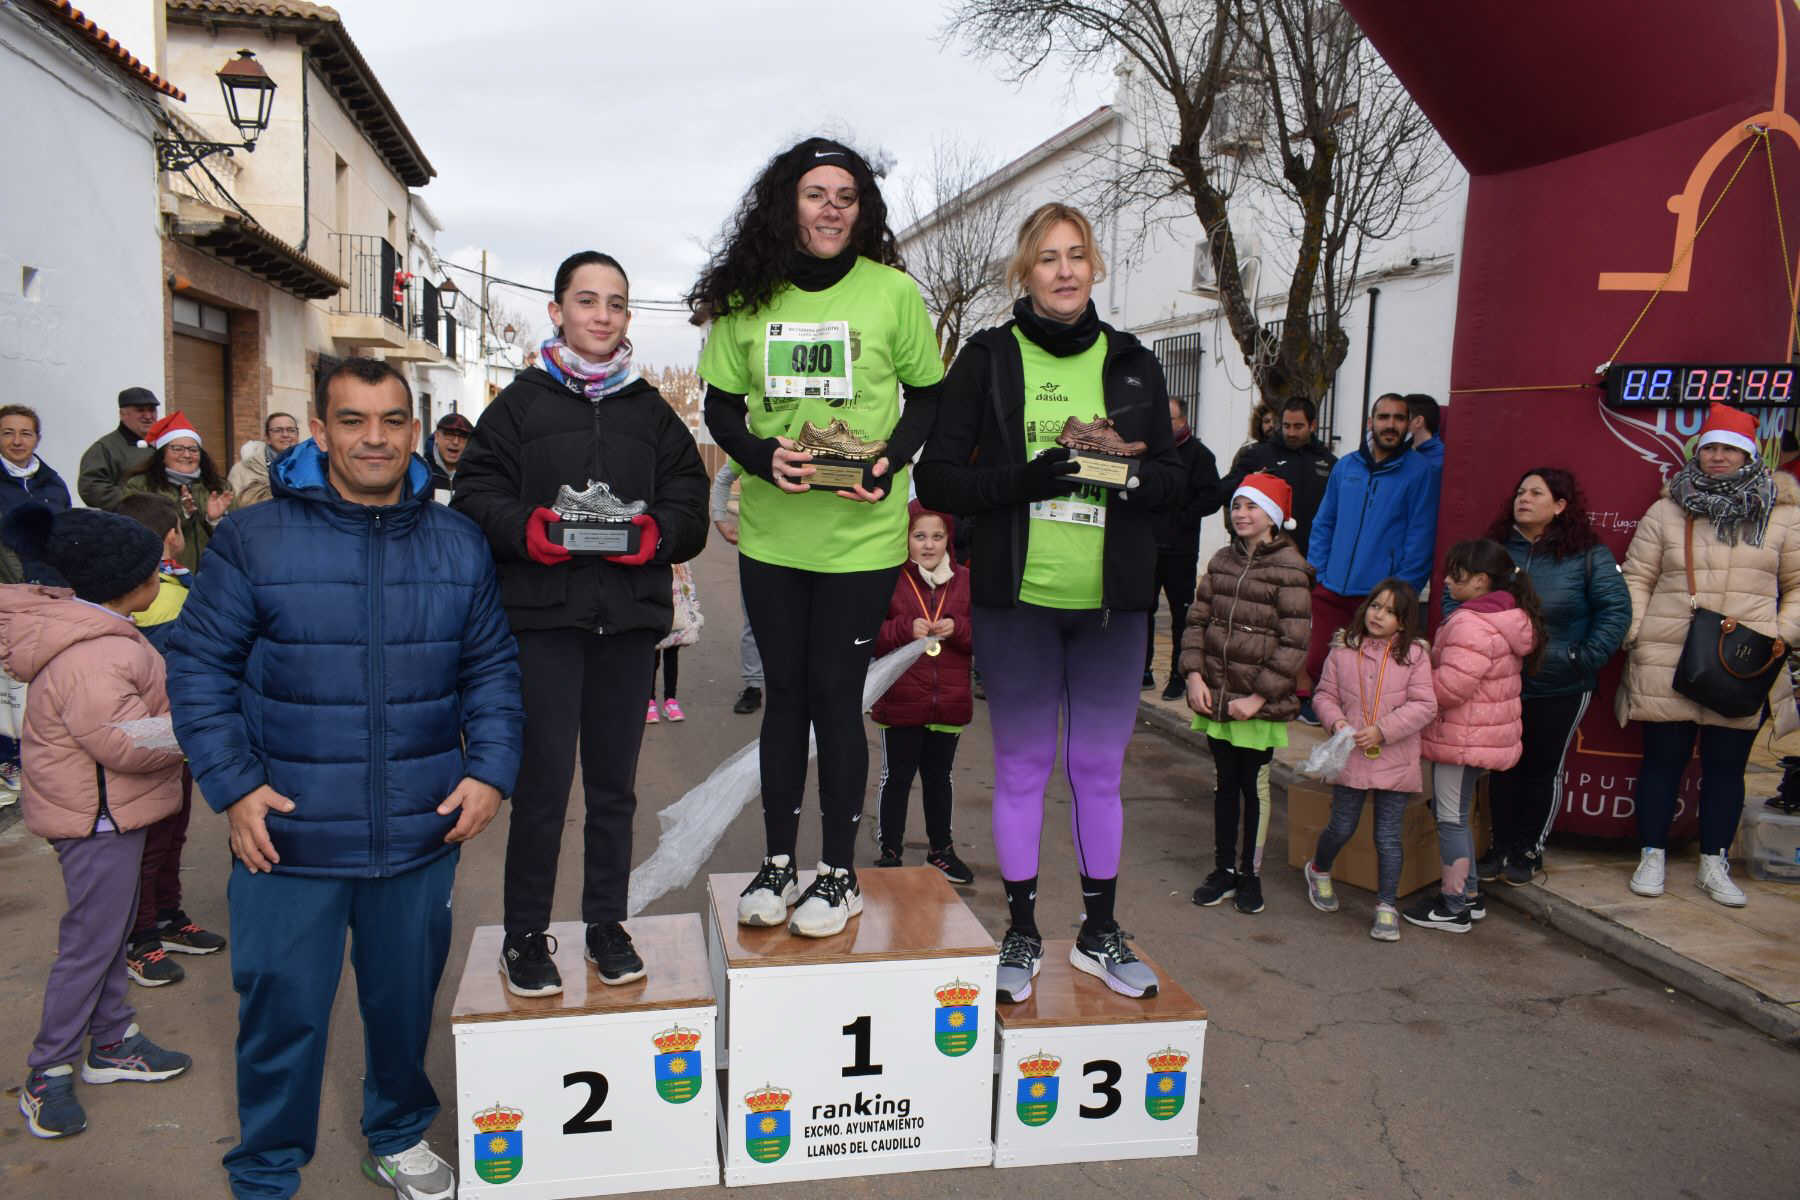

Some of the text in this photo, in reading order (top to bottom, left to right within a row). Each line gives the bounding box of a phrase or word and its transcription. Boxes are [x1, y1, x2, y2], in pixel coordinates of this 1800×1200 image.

[841, 1015, 884, 1078] 1
[562, 1070, 613, 1136] 2
[812, 1091, 911, 1120] ranking
[1078, 1059, 1124, 1120] 3
[804, 1117, 925, 1139] EXCMO. AYUNTAMIENTO
[807, 1136, 921, 1158] LLANOS DEL CAUDILLO
